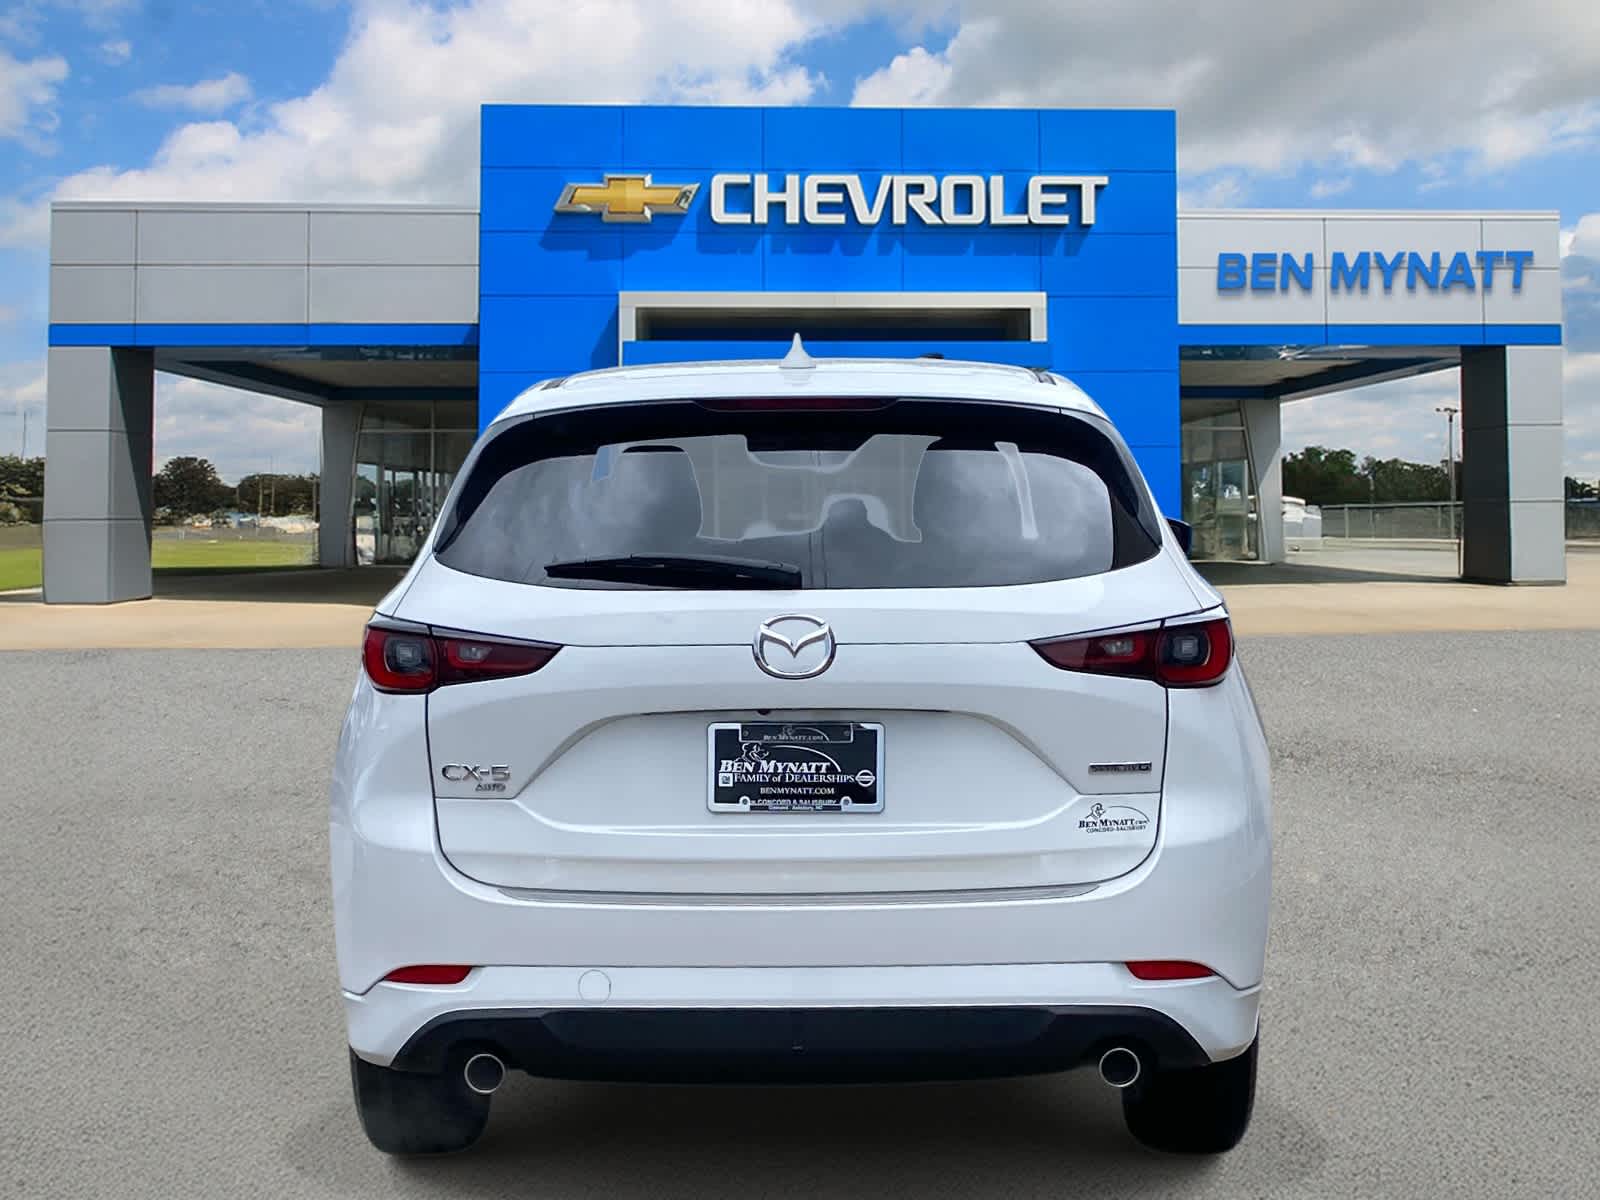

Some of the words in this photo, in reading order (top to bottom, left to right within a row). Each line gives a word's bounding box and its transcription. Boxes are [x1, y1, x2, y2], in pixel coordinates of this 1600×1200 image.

[710, 173, 1109, 226] CHEVROLET
[1217, 252, 1313, 290] BEN
[1330, 250, 1534, 290] MYNATT
[441, 763, 511, 781] CX-5
[719, 760, 756, 773] BEN
[758, 760, 831, 773] MYNATT
[734, 773, 770, 783] FAMILY
[785, 773, 855, 783] DEALERSHIPS
[760, 787, 835, 795] BENMYNATT.COM
[1078, 820, 1098, 828] BEN
